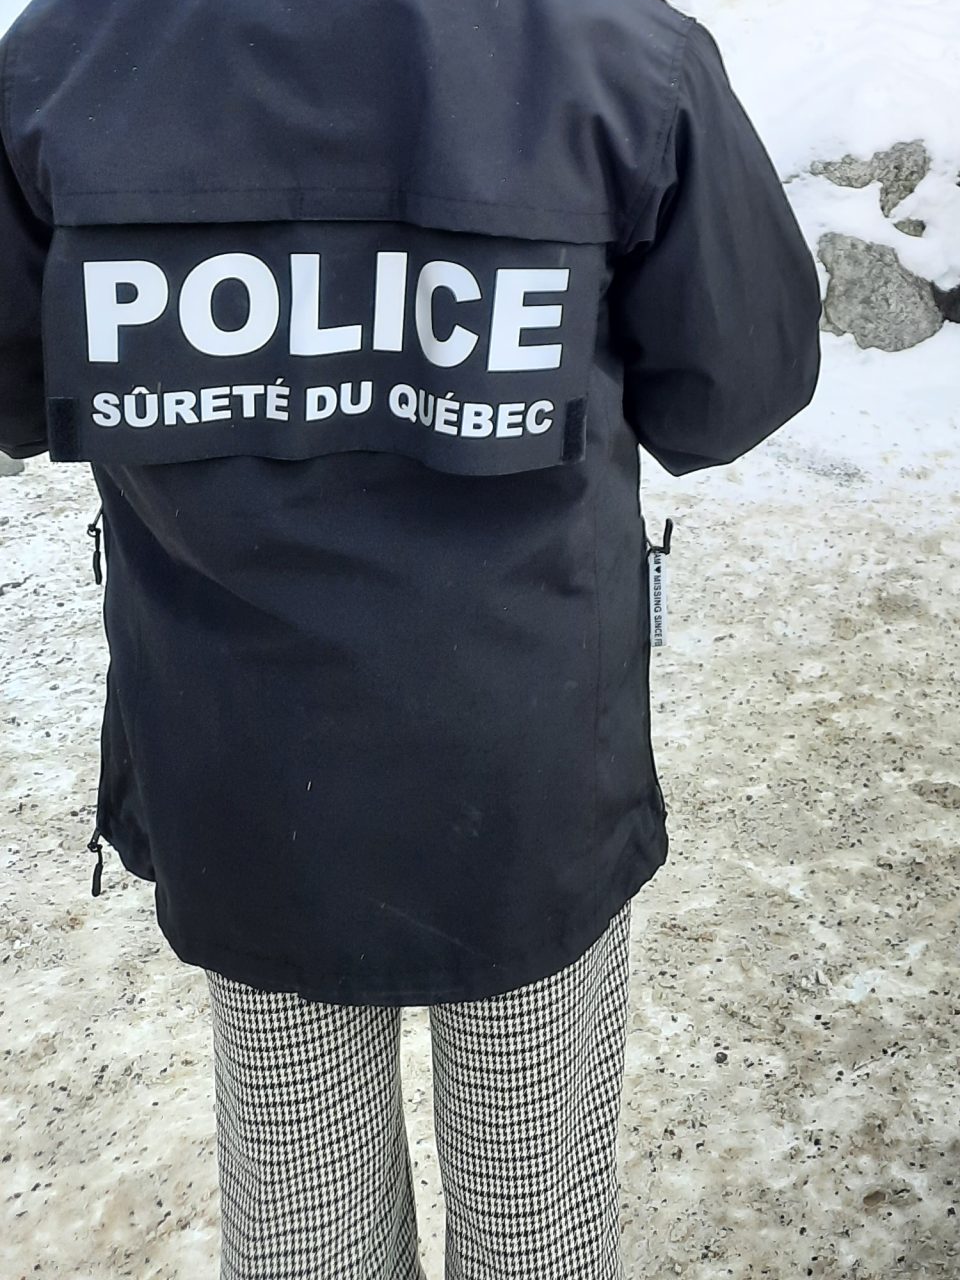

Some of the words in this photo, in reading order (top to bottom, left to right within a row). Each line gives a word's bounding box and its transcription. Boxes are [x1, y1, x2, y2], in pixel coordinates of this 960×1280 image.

[83, 251, 570, 372] POLICE
[92, 378, 291, 428] SÛRETÉ
[305, 381, 374, 421] DU
[388, 383, 555, 439] QUÉBEC
[653, 575, 662, 613] MISSING
[654, 614, 663, 638] SINCE
